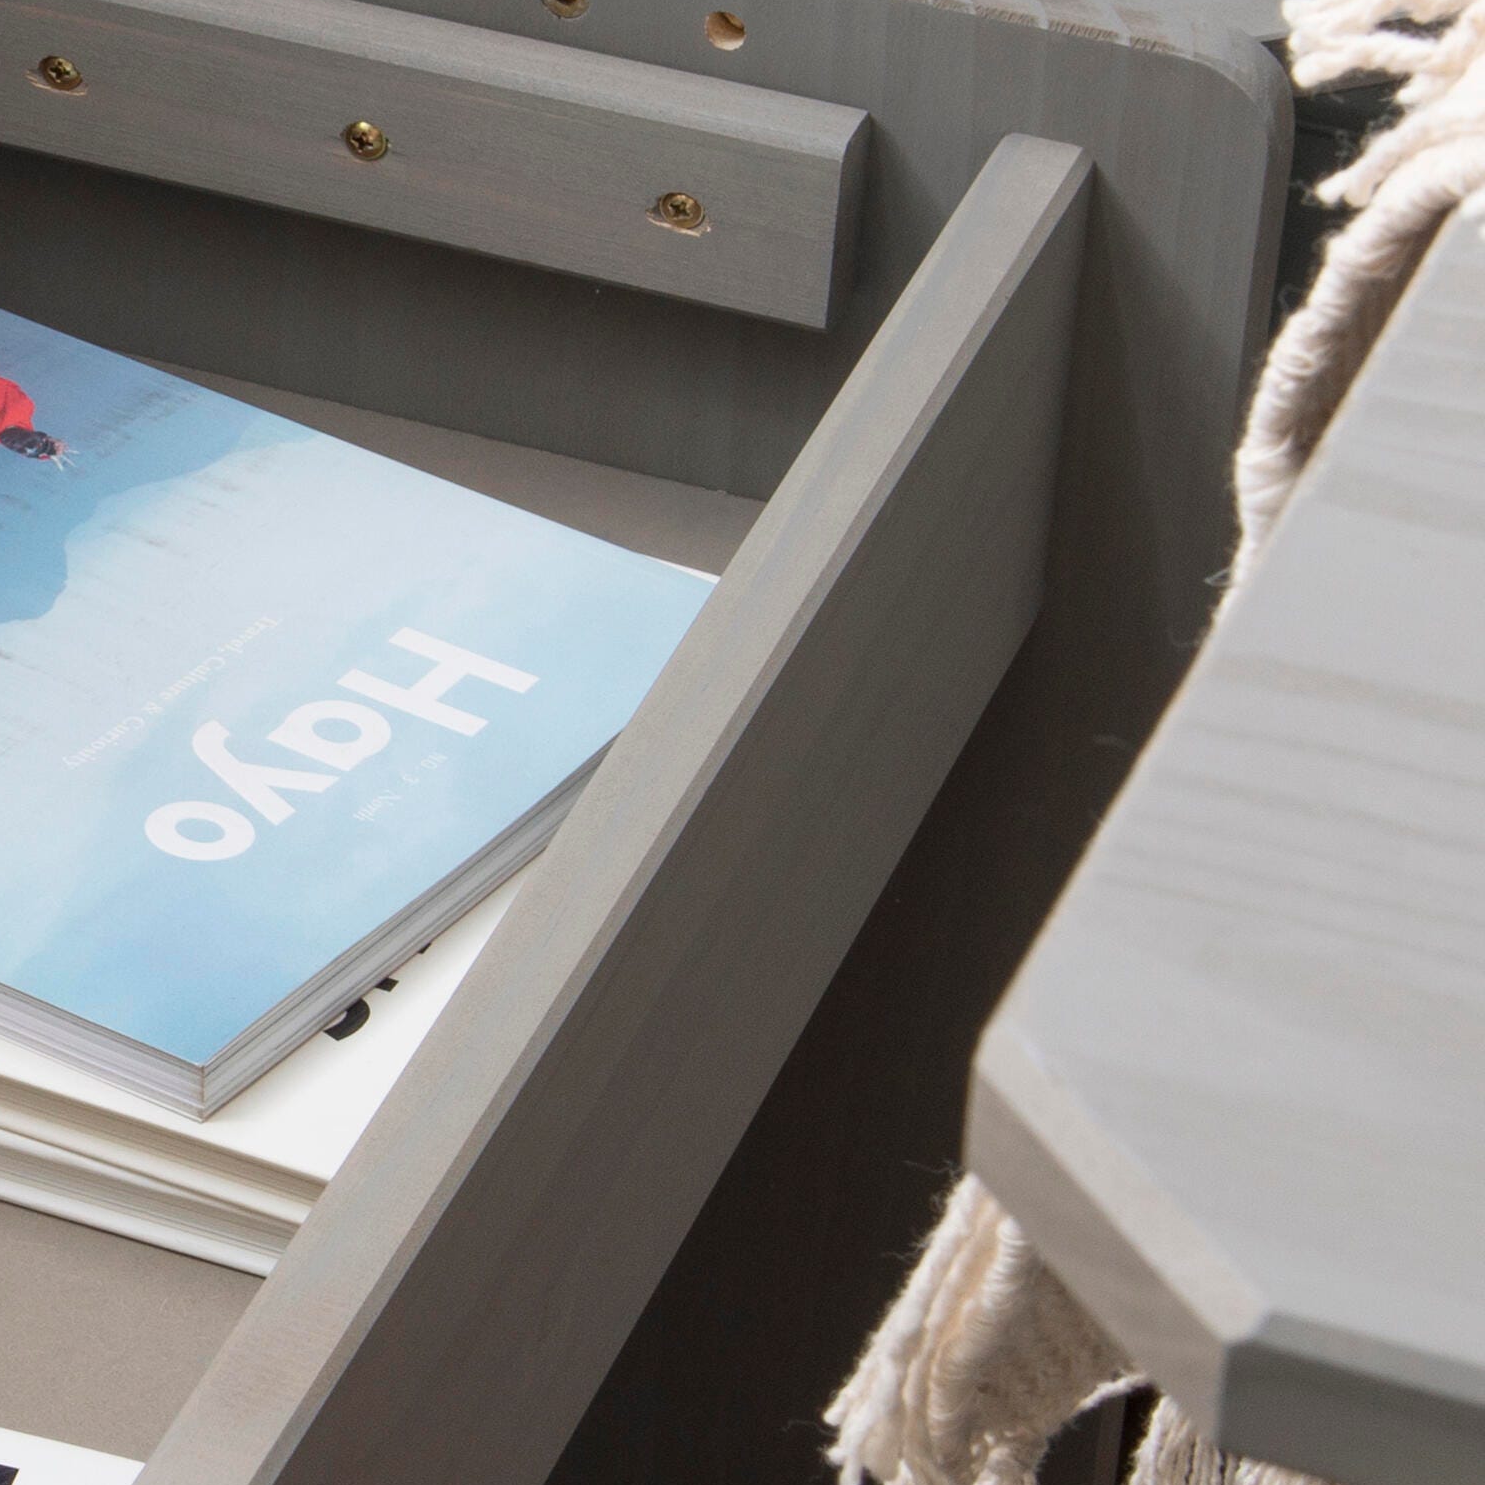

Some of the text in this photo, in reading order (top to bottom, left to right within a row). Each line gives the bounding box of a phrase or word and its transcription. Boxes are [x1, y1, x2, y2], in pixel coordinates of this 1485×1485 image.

[61, 617, 283, 770] Travel, Culture & Curiosity
[144, 626, 541, 862] Hayo
[351, 788, 402, 821] North
